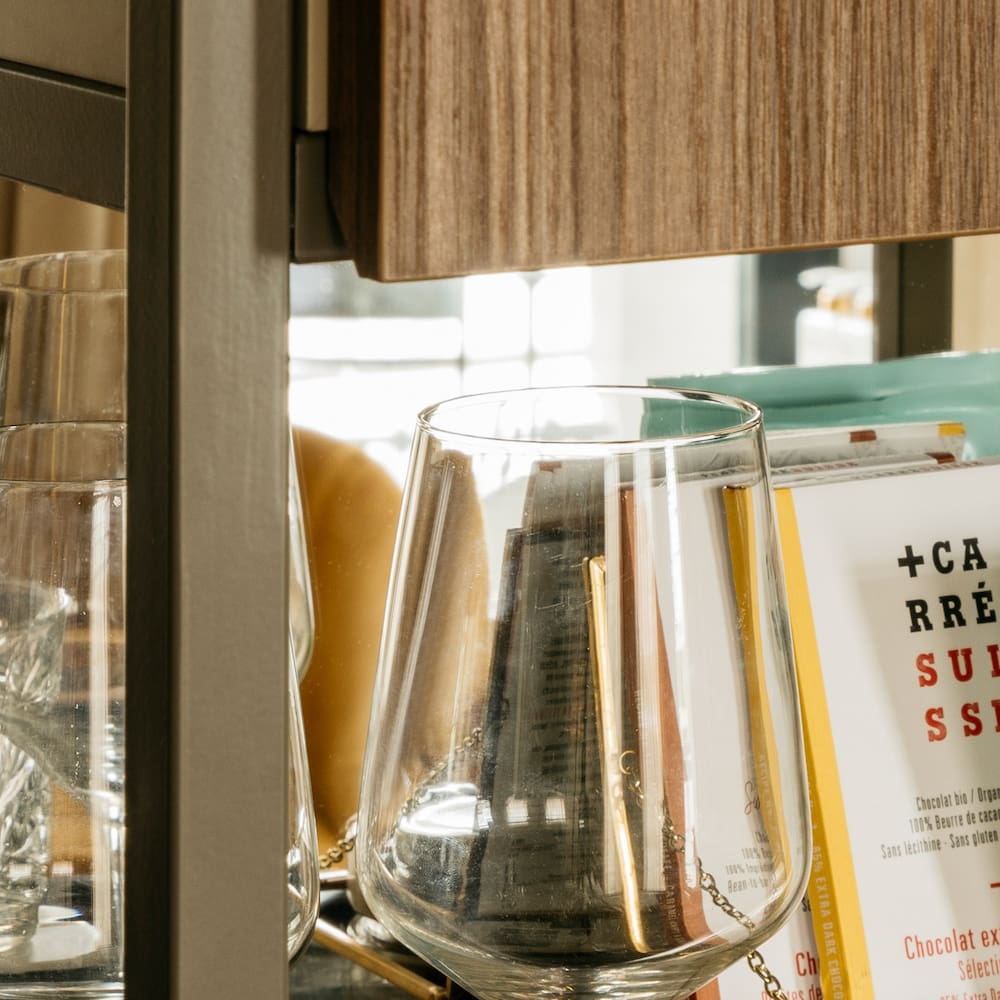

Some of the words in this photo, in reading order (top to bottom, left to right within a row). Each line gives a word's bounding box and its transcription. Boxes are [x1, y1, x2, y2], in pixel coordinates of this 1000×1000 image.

[905, 581, 997, 633] RRÉ
[916, 794, 952, 812] Chocolat
[954, 791, 968, 806] bio
[909, 816, 933, 834] 100%
[935, 813, 964, 831] Beurre
[966, 811, 976, 825] de
[880, 843, 902, 860] Sans
[949, 832, 970, 850] Sans
[972, 828, 999, 847] gluten
[815, 876, 831, 921] EXTRA
[821, 920, 839, 959] DARK
[904, 927, 975, 960] Chocolat
